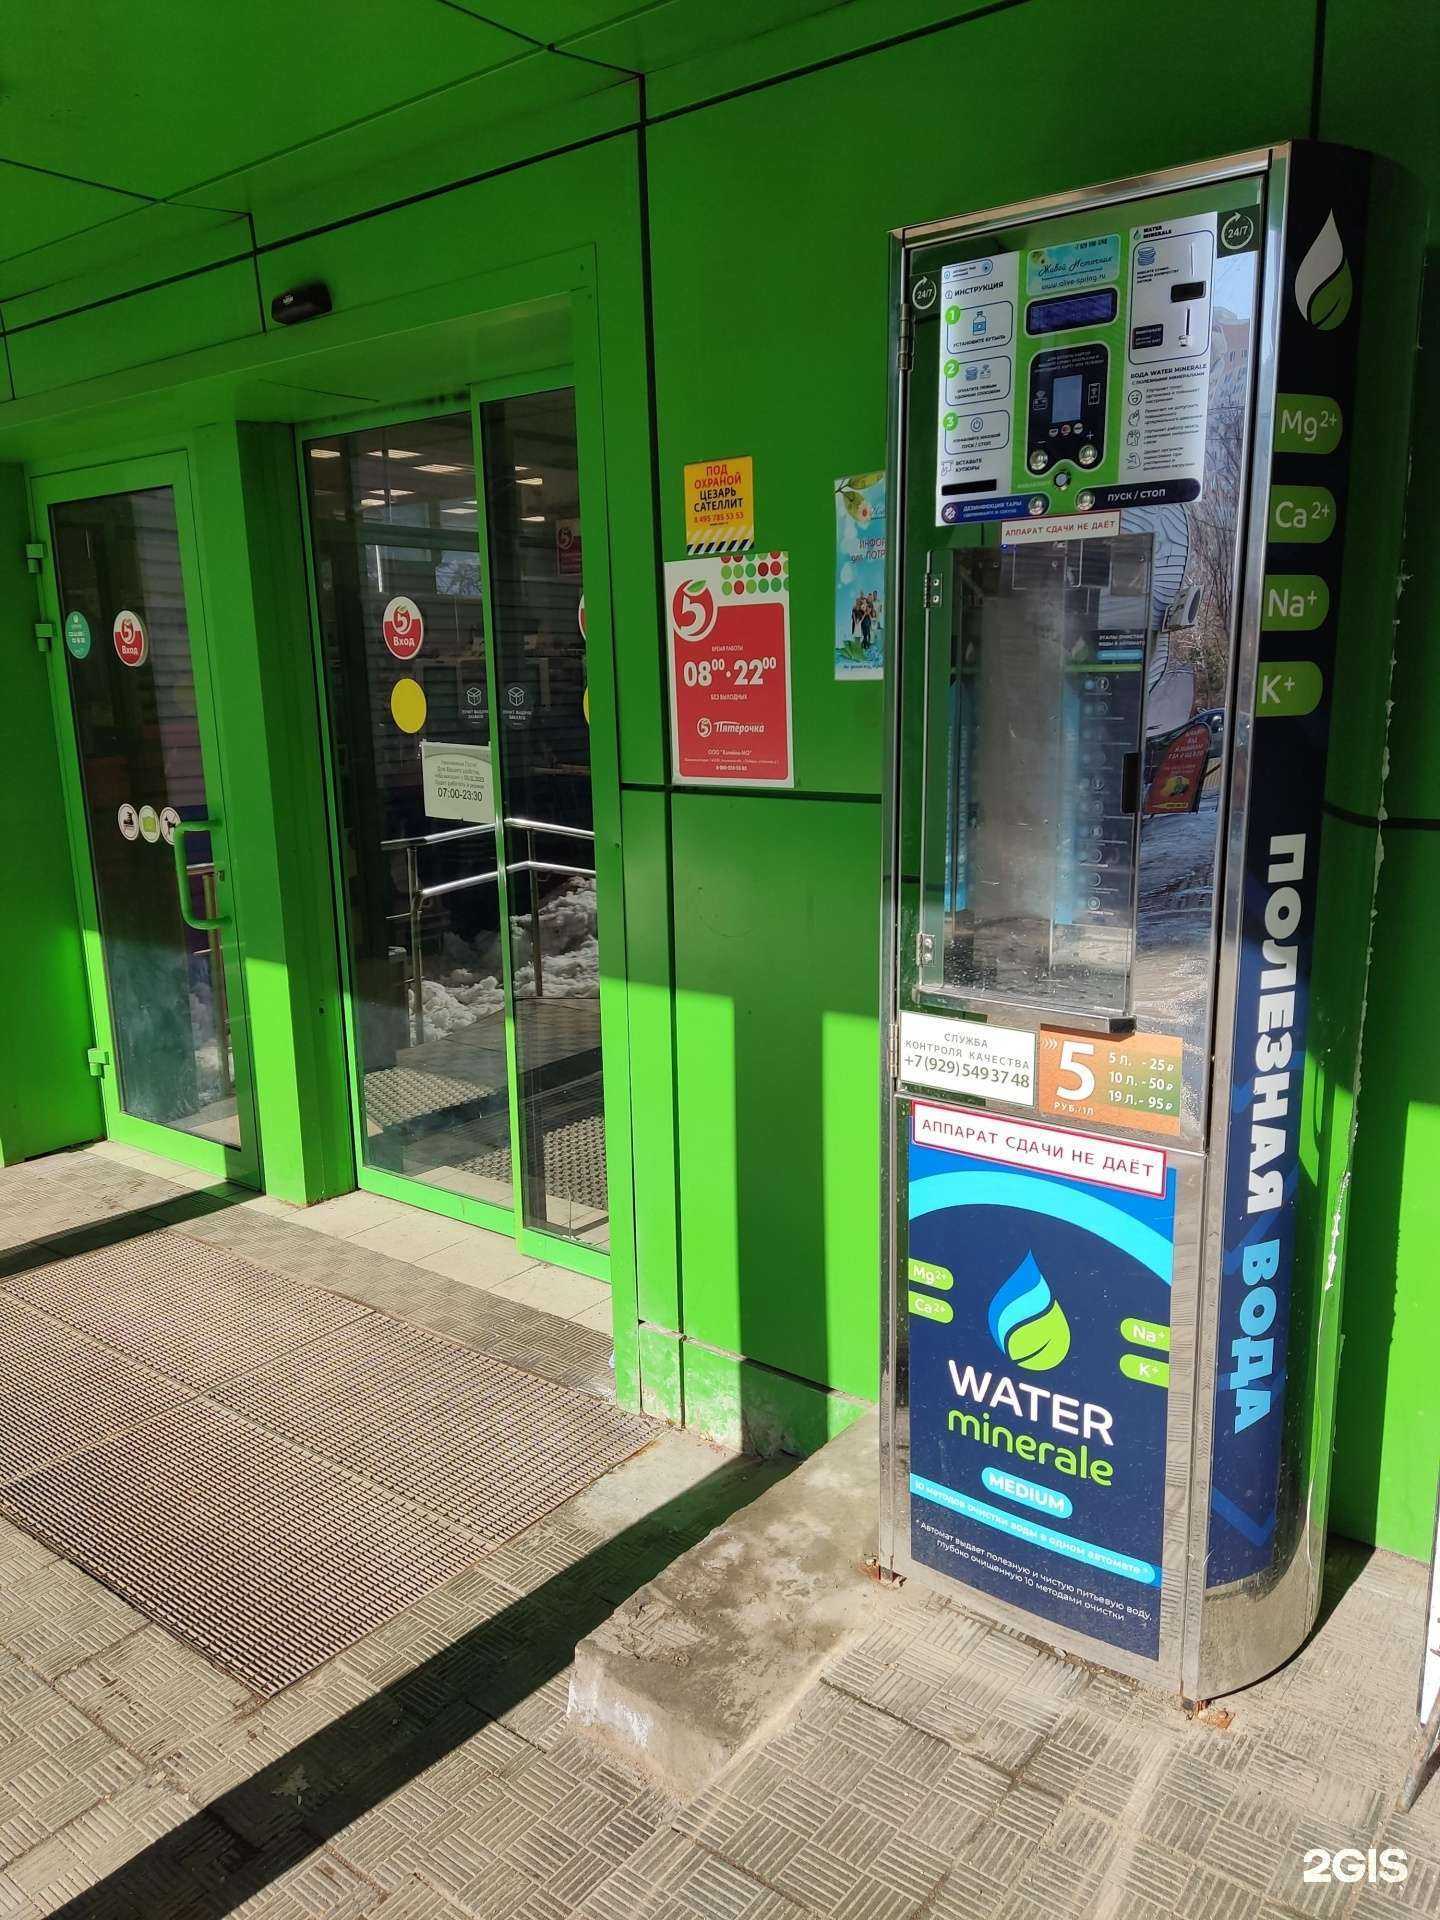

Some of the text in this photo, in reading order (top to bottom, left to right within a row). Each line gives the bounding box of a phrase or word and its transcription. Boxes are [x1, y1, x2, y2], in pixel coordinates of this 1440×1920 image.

[1228, 225, 1248, 239] 24/7
[916, 288, 933, 300] 24/7
[954, 281, 1004, 296] ИНСТРУКЦИЯ
[948, 364, 956, 375] 2
[1150, 368, 1173, 376] WATER
[1174, 364, 1207, 372] MINERALE
[947, 416, 955, 427] 3
[706, 464, 728, 476] ПОД
[694, 472, 742, 489] ОХРАНОЙ
[700, 487, 736, 500] ЦЕЗАРЬ
[1107, 491, 1132, 502] ПУСК
[1140, 488, 1166, 499] СТОП
[694, 498, 744, 512] САТЕЛЛИТ
[1005, 526, 1043, 537] АППАРАТ
[1046, 524, 1074, 534] СДАЧИ
[1076, 522, 1089, 532] НЕ
[1267, 588, 1318, 618] Na+
[393, 636, 415, 647] Вход
[122, 646, 138, 656] Вход
[1261, 674, 1296, 705] K+
[438, 787, 483, 802] 07:00-23:30
[1247, 833, 1307, 1214] ПОЛЕЗНАЯ
[944, 1032, 988, 1048] СЛУЖБА
[905, 1040, 1030, 1070] КОНТРОЛЯ КАЧЕСТВА
[1109, 1052, 1116, 1064] 5
[1056, 1040, 1094, 1101] 5
[1110, 1072, 1123, 1084] 10
[1108, 1090, 1122, 1102] 19
[922, 1118, 1154, 1178] АППАРАТ СДАЧИ НЕ ДАЁТ
[1234, 1238, 1281, 1435] ВОДА
[948, 1359, 1114, 1446] WATER
[948, 1409, 1114, 1487] minerale
[988, 1472, 1066, 1513] MEDIUM
[925, 1486, 966, 1509] методов
[968, 1504, 1008, 1528] очистки
[1010, 1520, 1038, 1538] воды
[1048, 1537, 1085, 1555] одном
[1087, 1551, 1140, 1574] автомате
[920, 1522, 1152, 1621] Автомат выдает полезную и чистую питьевую воду,
[970, 1555, 1022, 1582] очищенную
[1025, 1576, 1034, 1586] 10
[1036, 1582, 1082, 1606] методами
[1084, 1602, 1125, 1621] очистки
